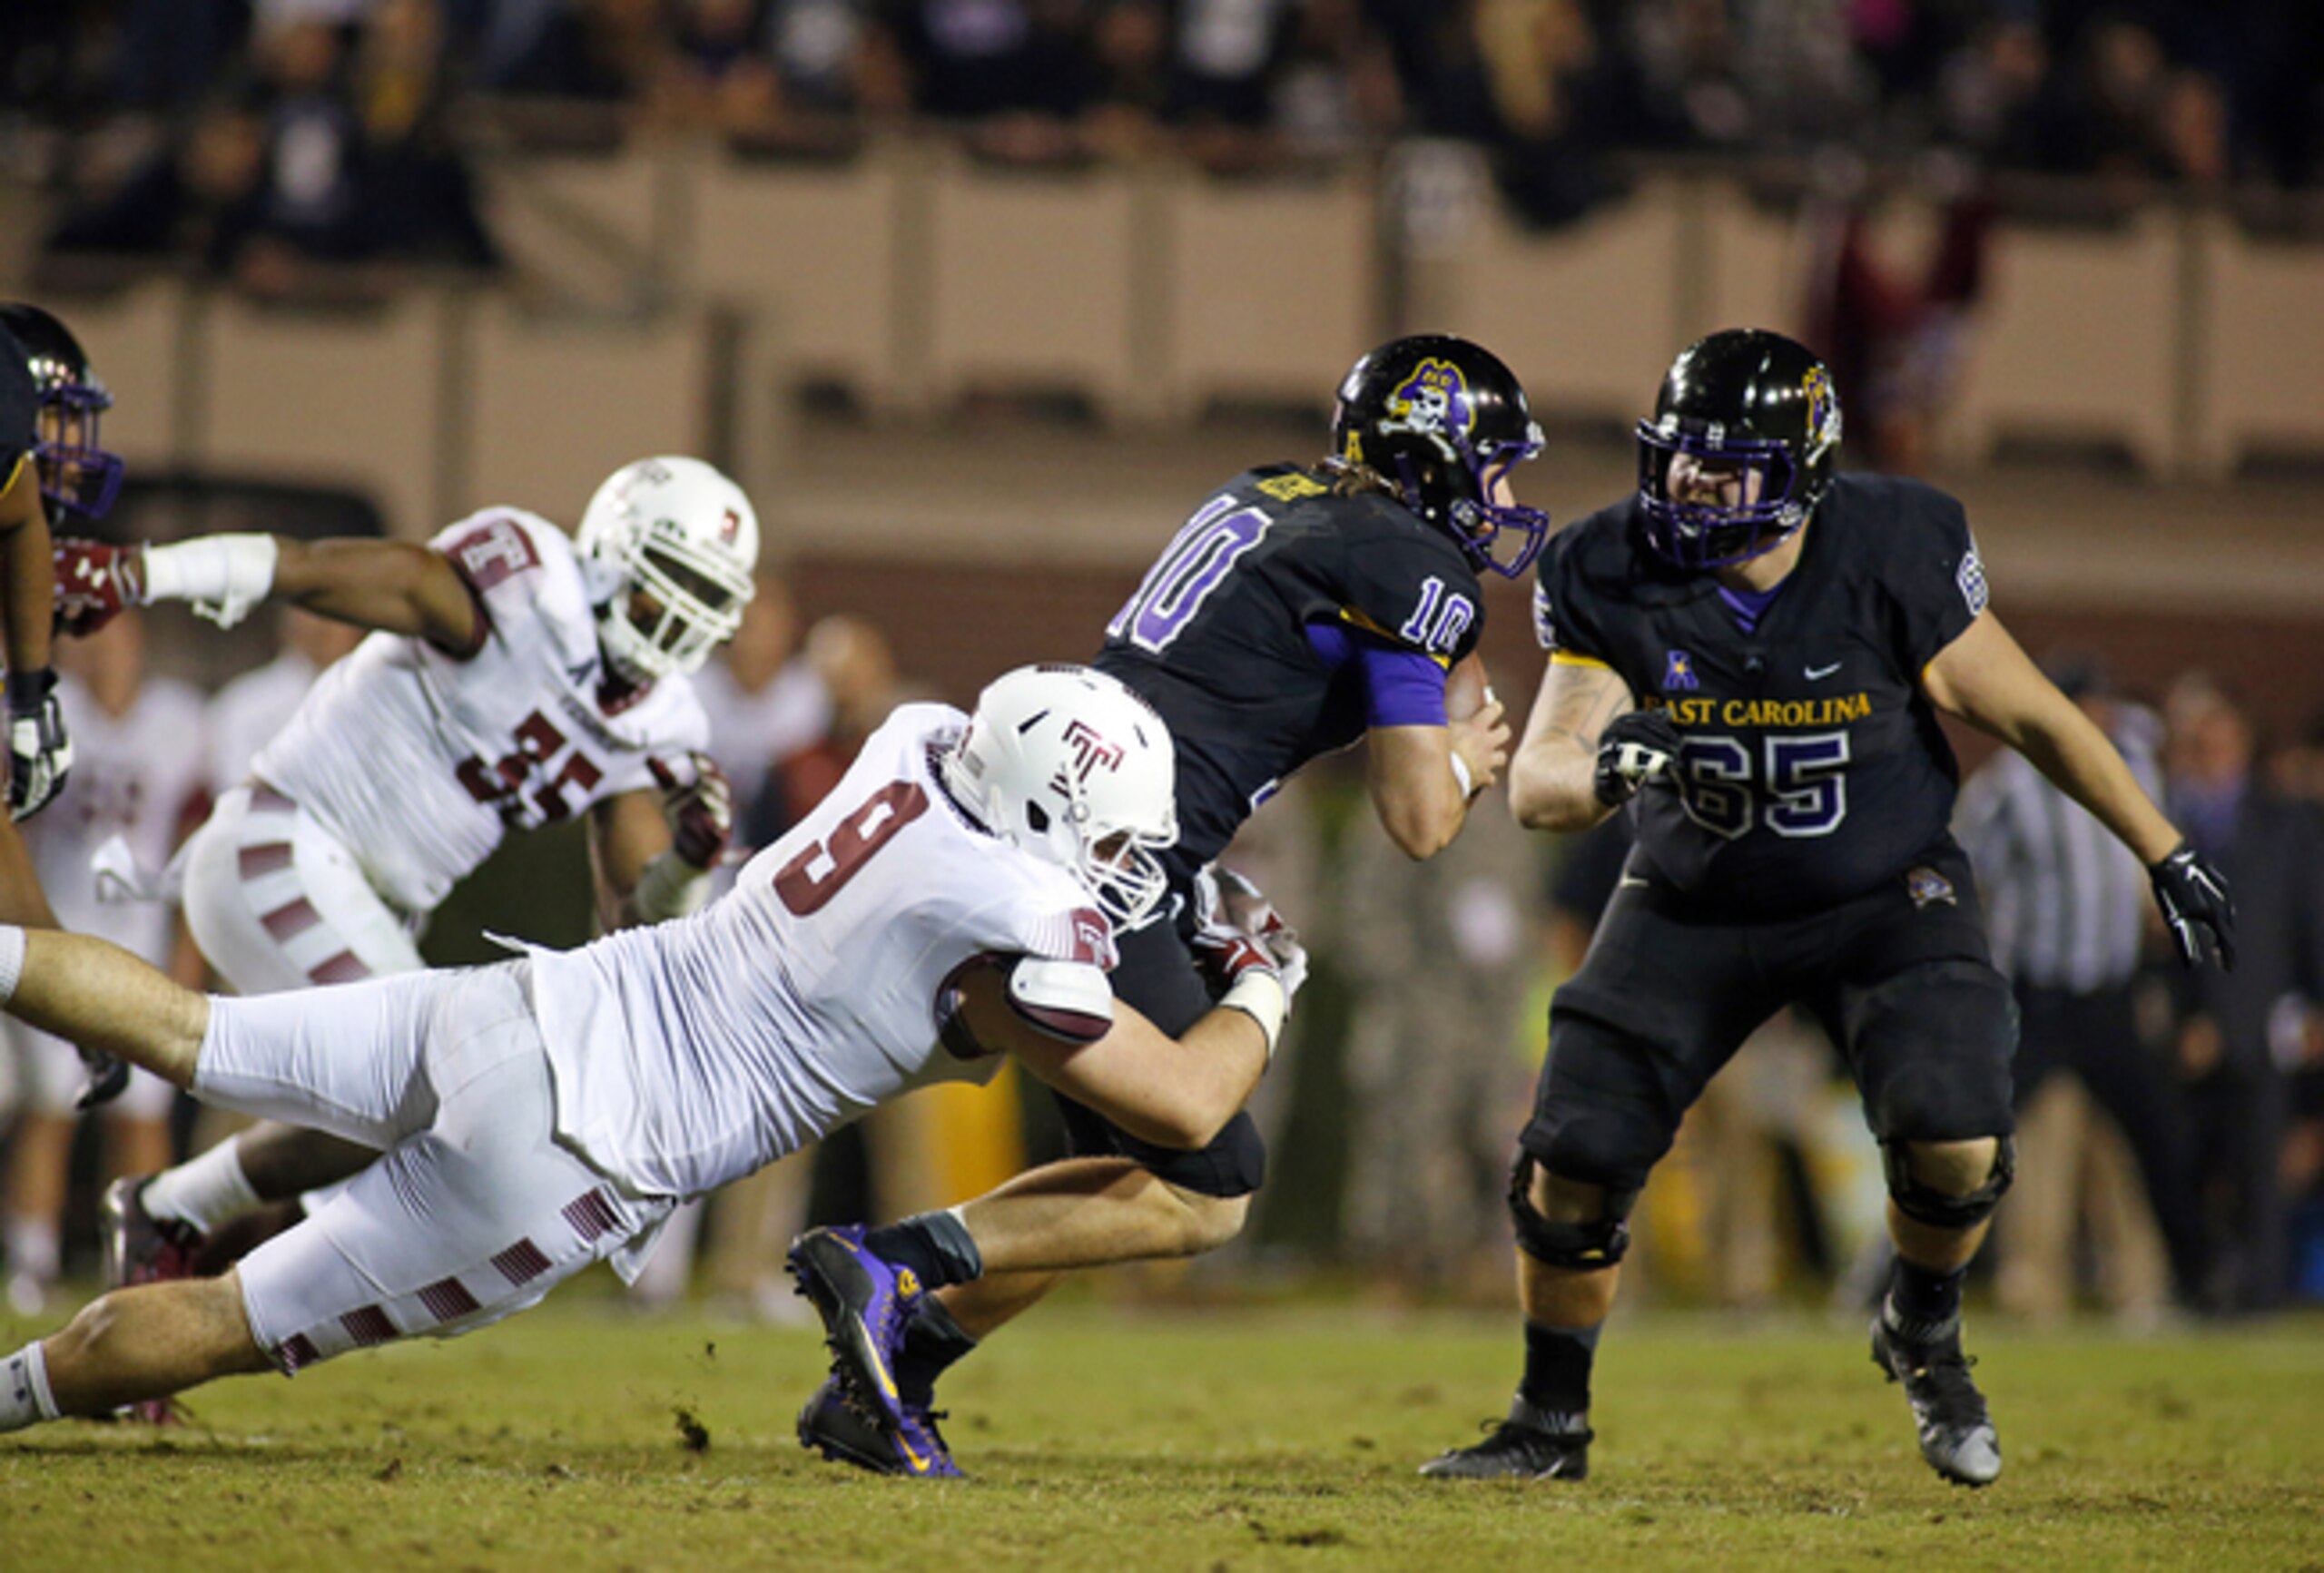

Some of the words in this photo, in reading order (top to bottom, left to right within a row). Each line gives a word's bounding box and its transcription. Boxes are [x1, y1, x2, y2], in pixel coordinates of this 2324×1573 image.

[1105, 494, 1274, 654] 10
[1401, 575, 1473, 653] 10
[1721, 692, 1872, 726] CAROLINA
[1671, 731, 1850, 840] 65
[773, 780, 930, 917] 9
